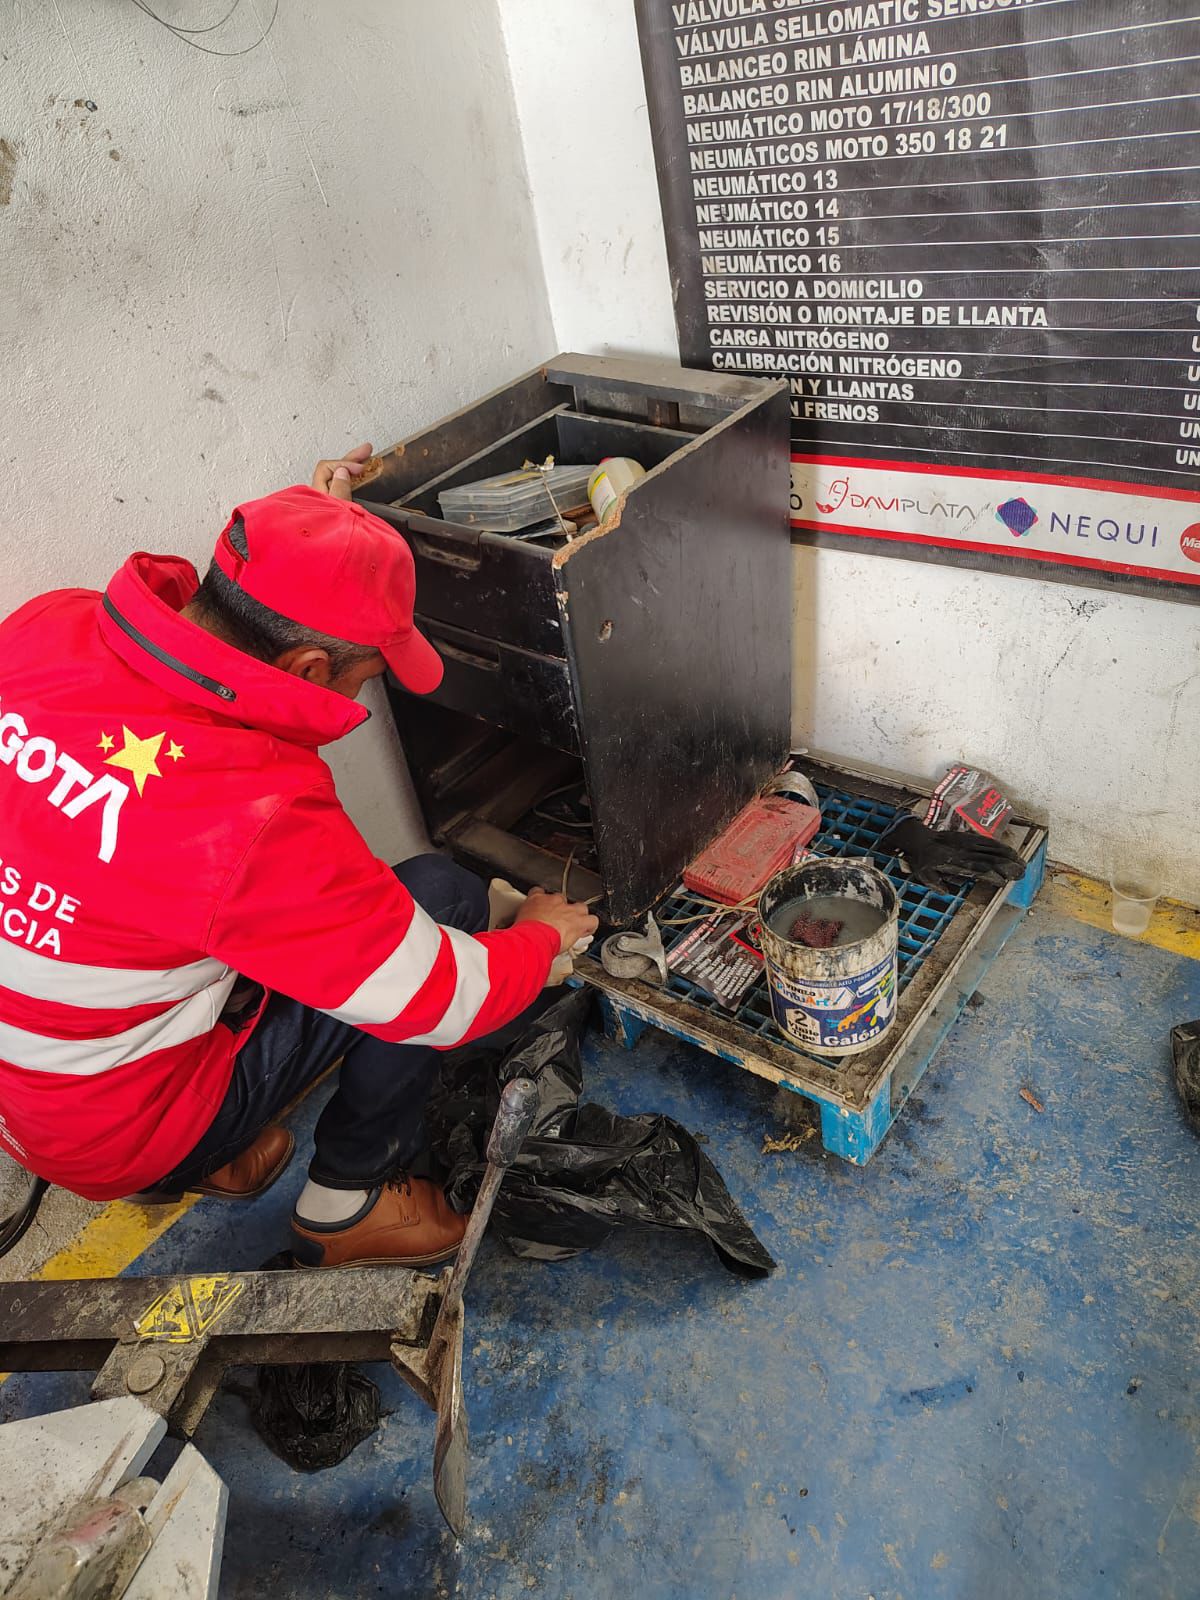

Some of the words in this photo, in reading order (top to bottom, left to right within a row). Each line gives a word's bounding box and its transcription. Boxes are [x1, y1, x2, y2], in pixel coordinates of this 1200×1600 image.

[675, 23, 769, 57] VÁLVULA
[774, 0, 920, 42] SELLOMATIC
[679, 52, 788, 87] BALANCEO
[794, 45, 832, 72] RIN
[839, 30, 931, 66] LÁMINA
[683, 83, 789, 116] BALANCEO
[796, 77, 833, 102] RIN
[840, 62, 957, 98] ALUMINIO
[686, 113, 804, 143] NEUMÁTICO
[810, 105, 873, 131] MOTO
[880, 92, 991, 125] 17/18/300
[690, 142, 819, 170] NEUMÁTICOS
[825, 134, 888, 160] MOTO
[895, 130, 936, 155] 350
[944, 127, 972, 151] 18
[980, 123, 1007, 149] 21
[693, 171, 807, 197] NEUMÁTICO
[813, 169, 838, 190] 13
[695, 198, 808, 223] NEUMÁTICO
[814, 198, 840, 219] 14
[698, 225, 810, 249] NEUMÁTICO
[816, 226, 840, 246] 15
[702, 251, 812, 273] NEUMÁTICO
[818, 253, 841, 273] 16
[704, 280, 789, 299] SERVICIO
[795, 280, 809, 298] A
[813, 279, 924, 299] DOMICILIO
[706, 302, 792, 323] REVISIÓN
[797, 305, 812, 323] O
[817, 306, 915, 325] MONTAJE
[921, 306, 951, 325] DE
[958, 306, 1048, 327] LLANTA
[709, 328, 771, 347] CARGA
[775, 327, 890, 351] NITRÓGENO
[712, 351, 833, 374] CALIBRACIÓN
[838, 354, 962, 378] NITRÓGENO
[808, 378, 821, 396] Y
[826, 379, 914, 401] LLANTAS
[804, 401, 880, 423] FRENOS
[850, 493, 977, 521] DAVIPLATA
[1049, 511, 1158, 548] NEQUI
[0, 706, 130, 864] GOTA
[27, 881, 82, 925] DE
[793, 1009, 809, 1028] 2
[823, 1025, 881, 1047] Galón
